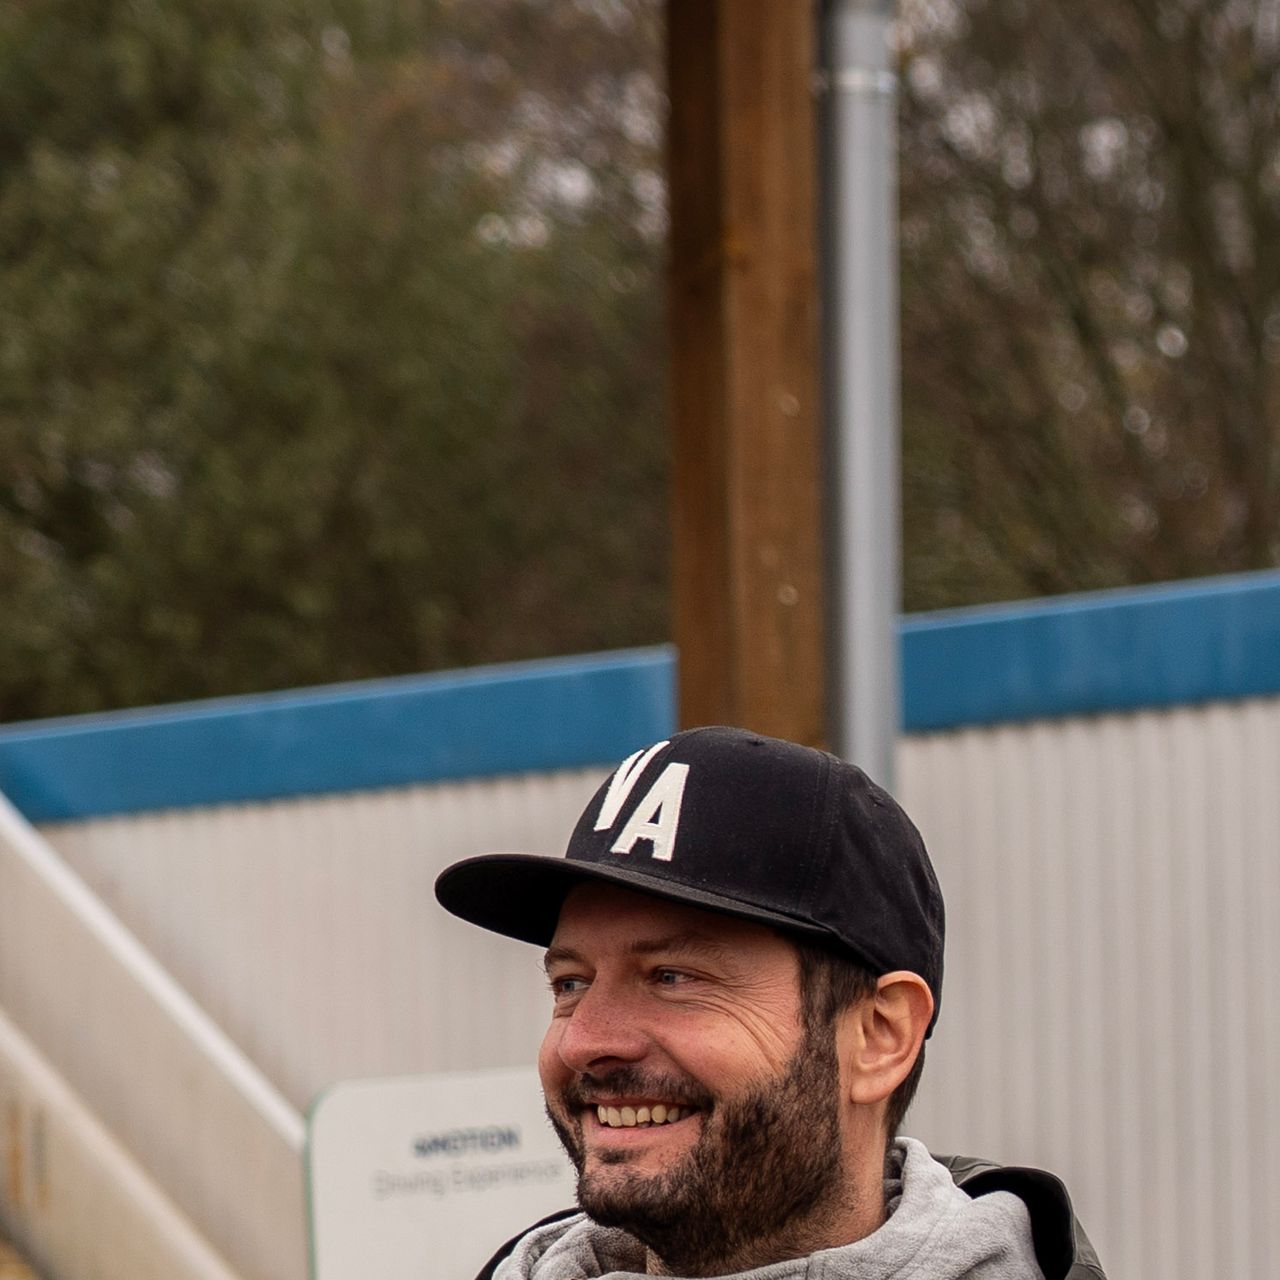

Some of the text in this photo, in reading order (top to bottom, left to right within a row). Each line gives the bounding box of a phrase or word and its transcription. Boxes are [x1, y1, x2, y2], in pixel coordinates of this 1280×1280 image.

[593, 740, 690, 861] VA
[372, 1161, 561, 1197] Driving Experience
